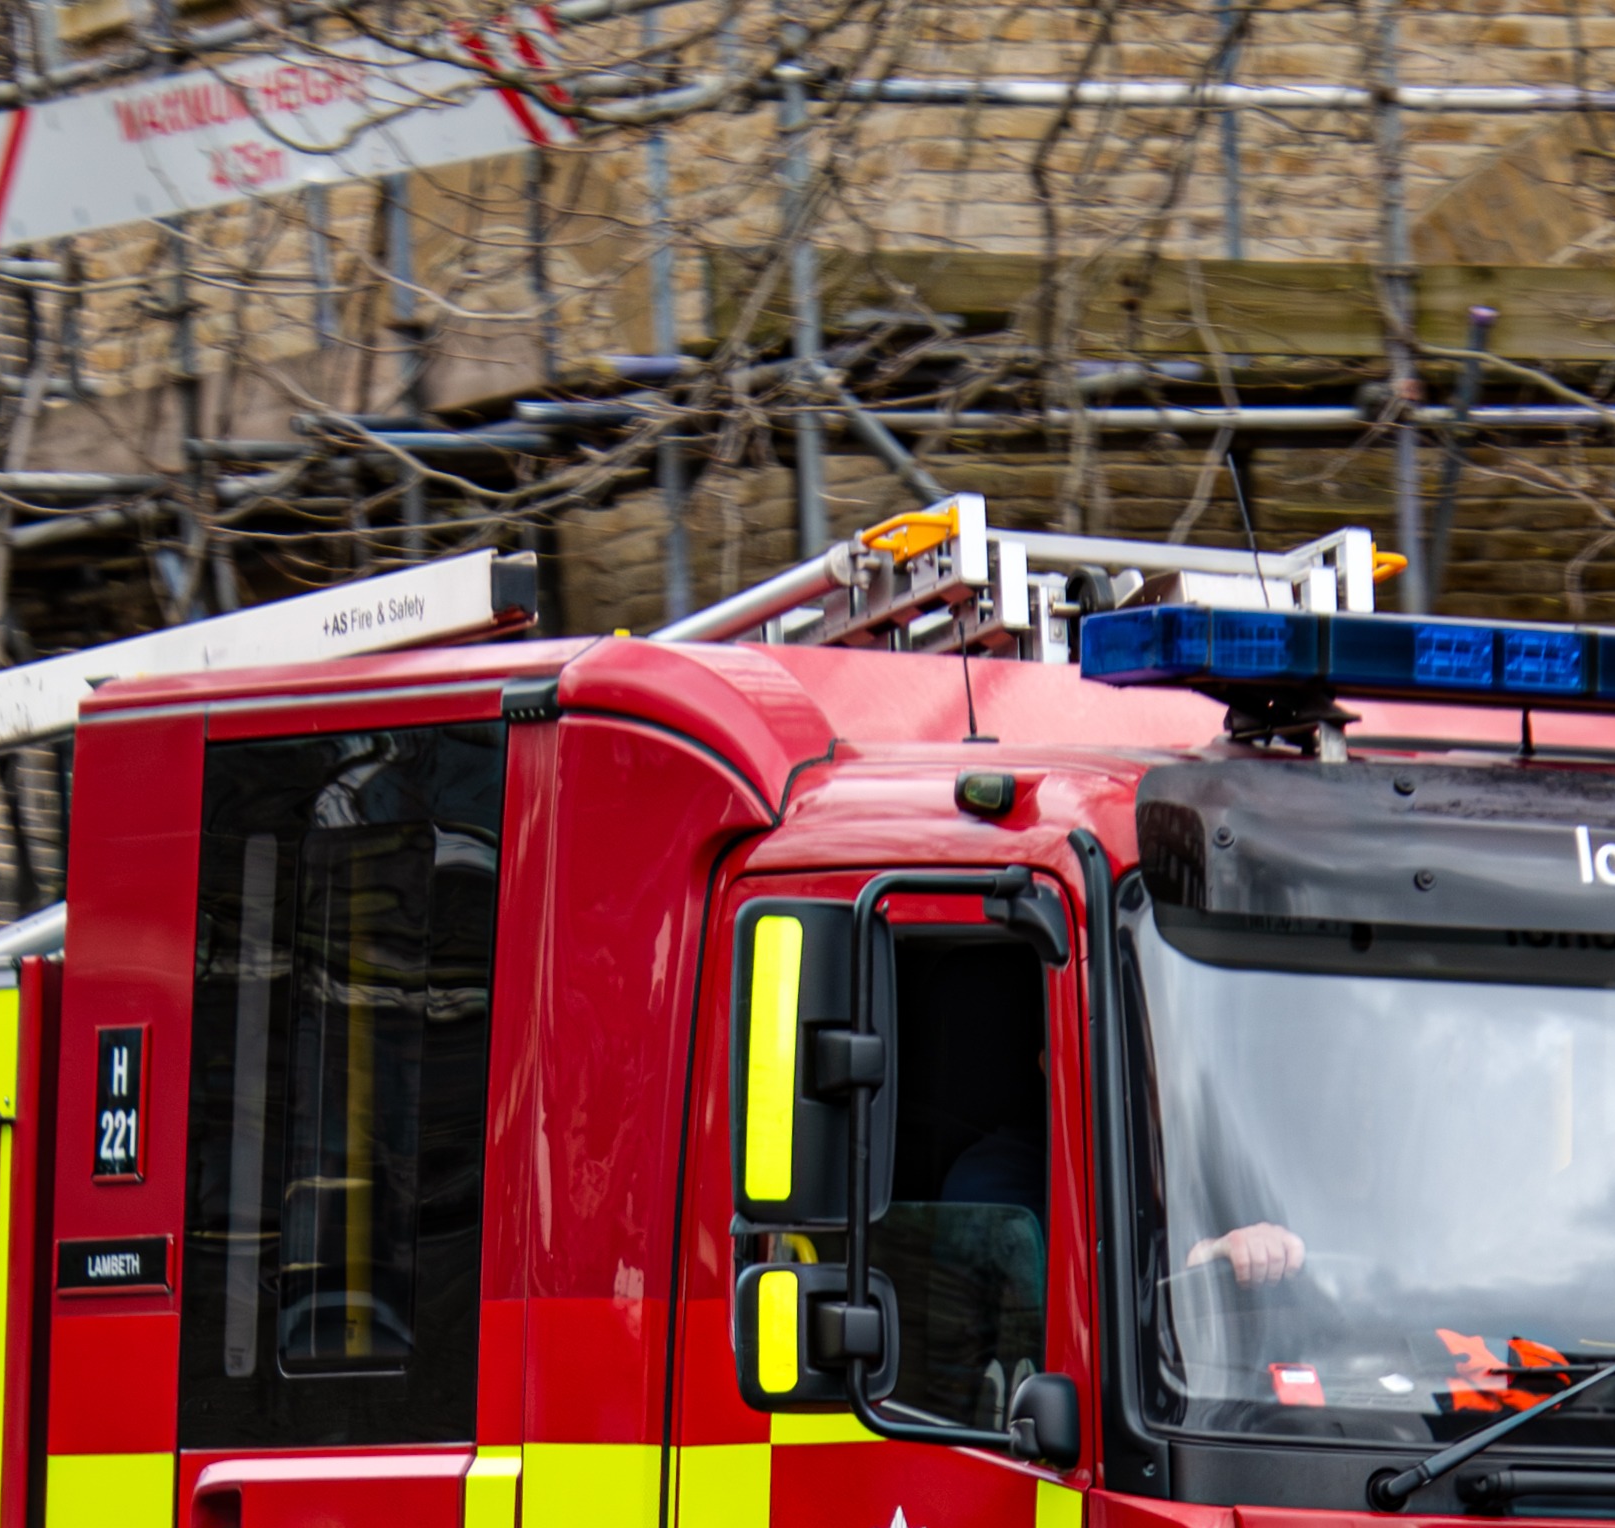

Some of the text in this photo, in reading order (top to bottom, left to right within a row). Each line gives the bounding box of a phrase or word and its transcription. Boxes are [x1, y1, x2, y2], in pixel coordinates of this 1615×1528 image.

[350, 606, 373, 633] Fire
[377, 600, 385, 624] &
[389, 594, 425, 621] Safety
[112, 1046, 128, 1097] H
[100, 1108, 137, 1160] 221
[88, 1252, 141, 1278] LAMBETH
